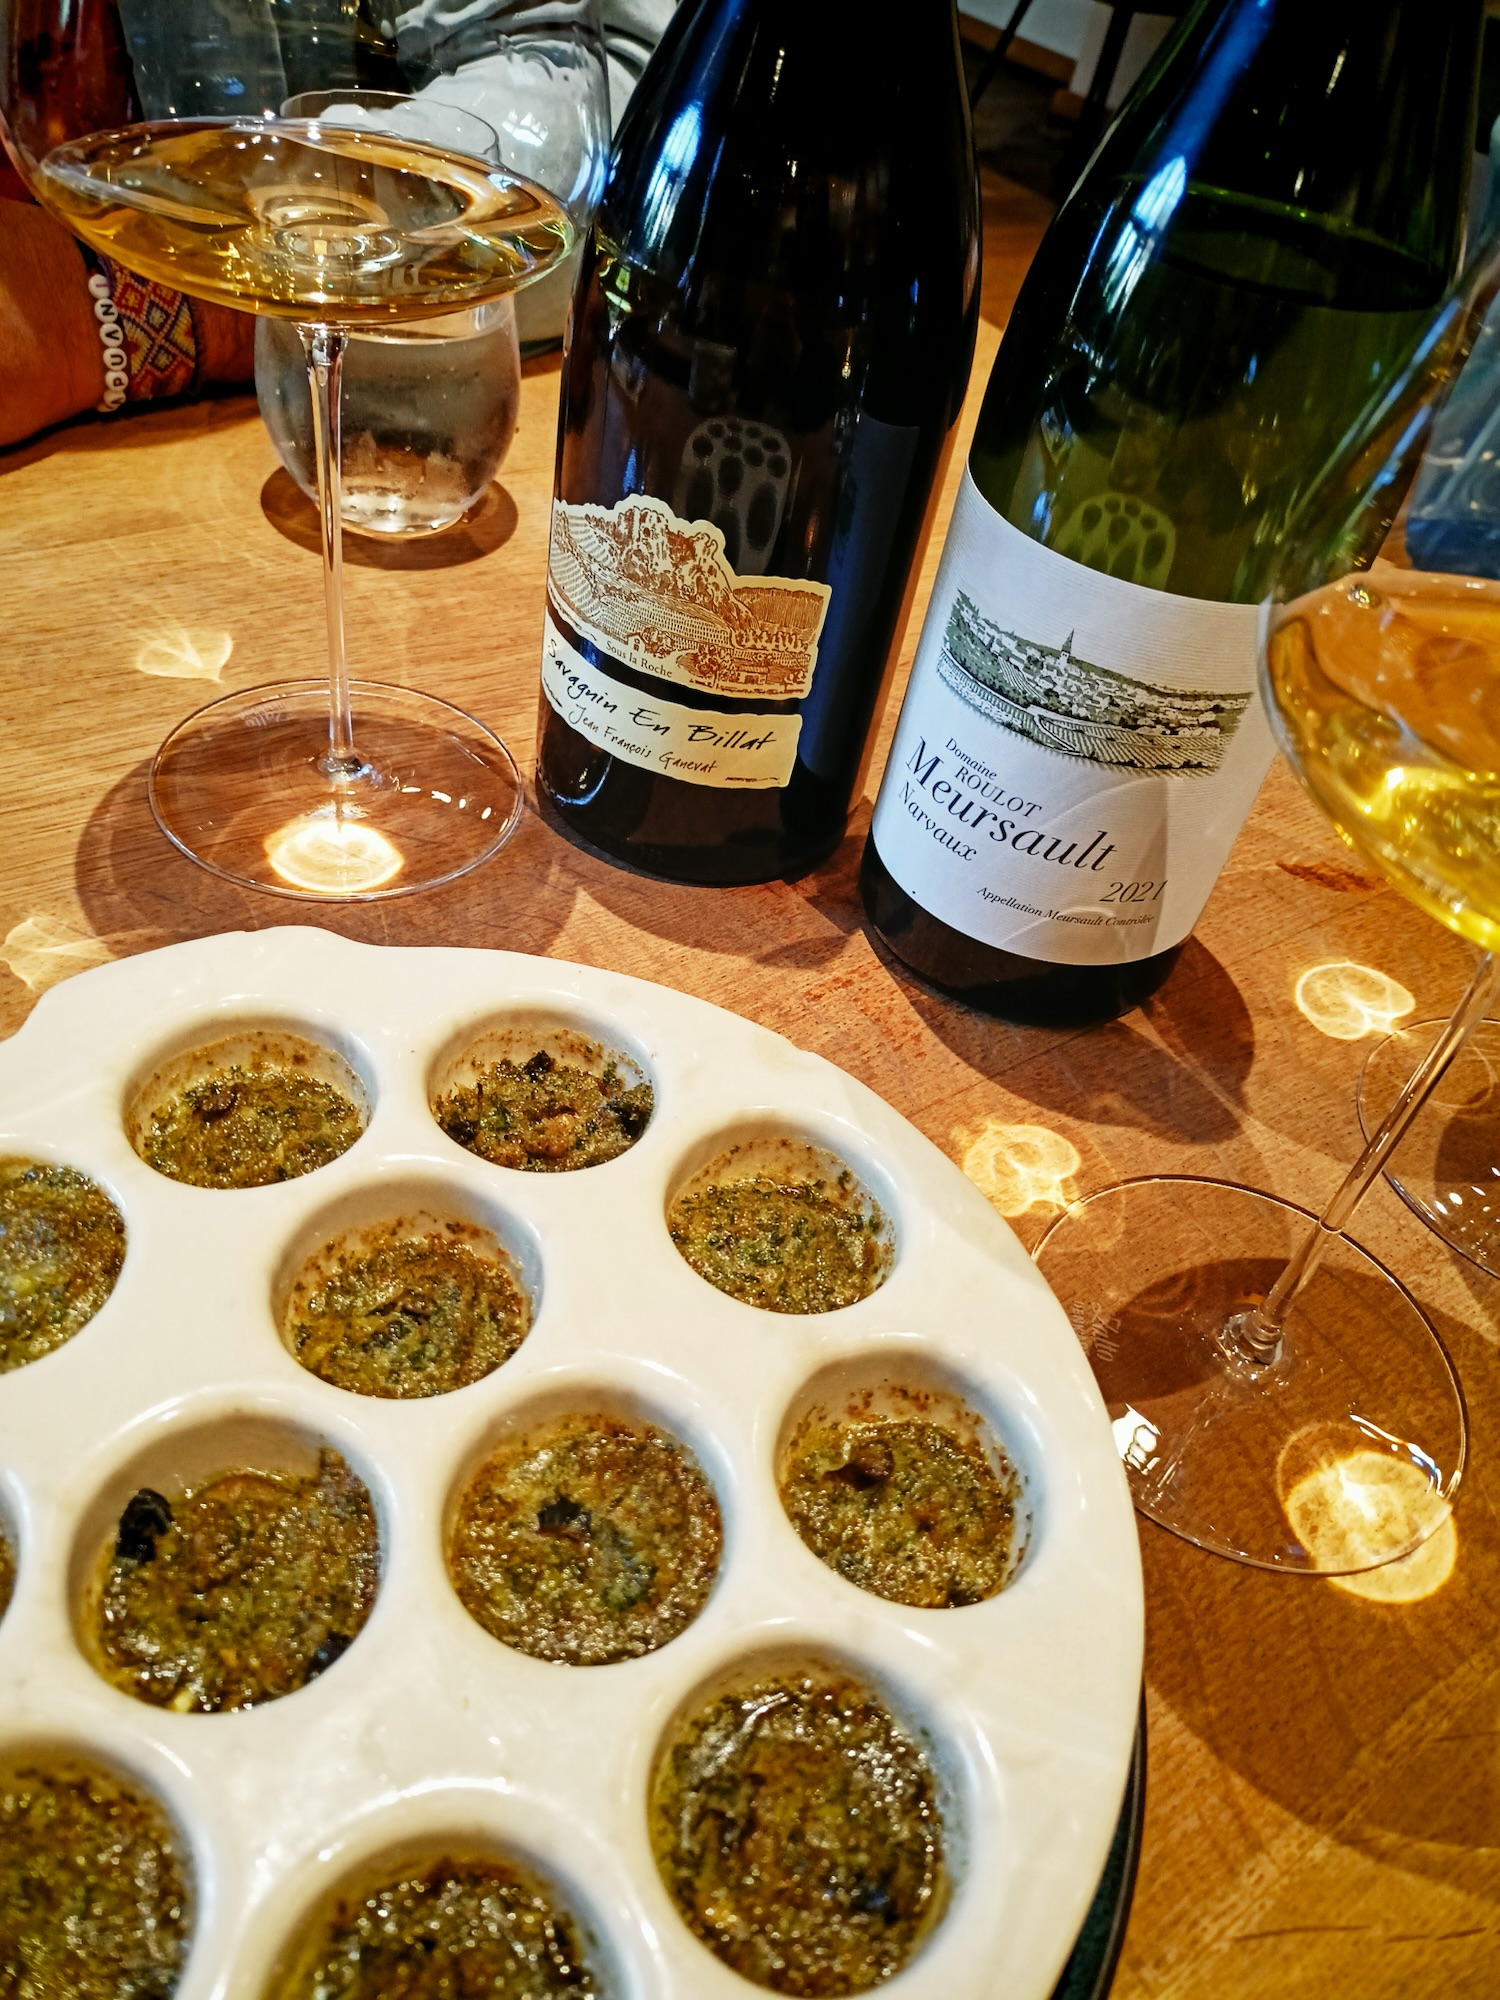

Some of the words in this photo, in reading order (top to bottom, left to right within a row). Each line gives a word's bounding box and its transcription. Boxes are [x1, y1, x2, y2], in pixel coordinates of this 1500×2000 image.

[605, 640, 627, 660] Sous
[629, 652, 637, 664] la
[641, 659, 673, 678] Roche
[547, 638, 618, 713] Savagnin
[629, 707, 671, 736] En
[687, 724, 777, 750] Billat
[568, 703, 600, 733] Jean
[603, 725, 653, 759] François
[658, 751, 718, 774] Ganevat
[945, 737, 998, 781] Domaine
[904, 735, 1118, 872] Meursault
[954, 765, 1042, 819] ROULOT
[898, 781, 978, 862] Narvaux
[976, 886, 1043, 918] Appellation
[1044, 909, 1103, 927] Meursault
[1099, 879, 1169, 903] 2021
[1091, 1301, 1121, 1361] Zalto
